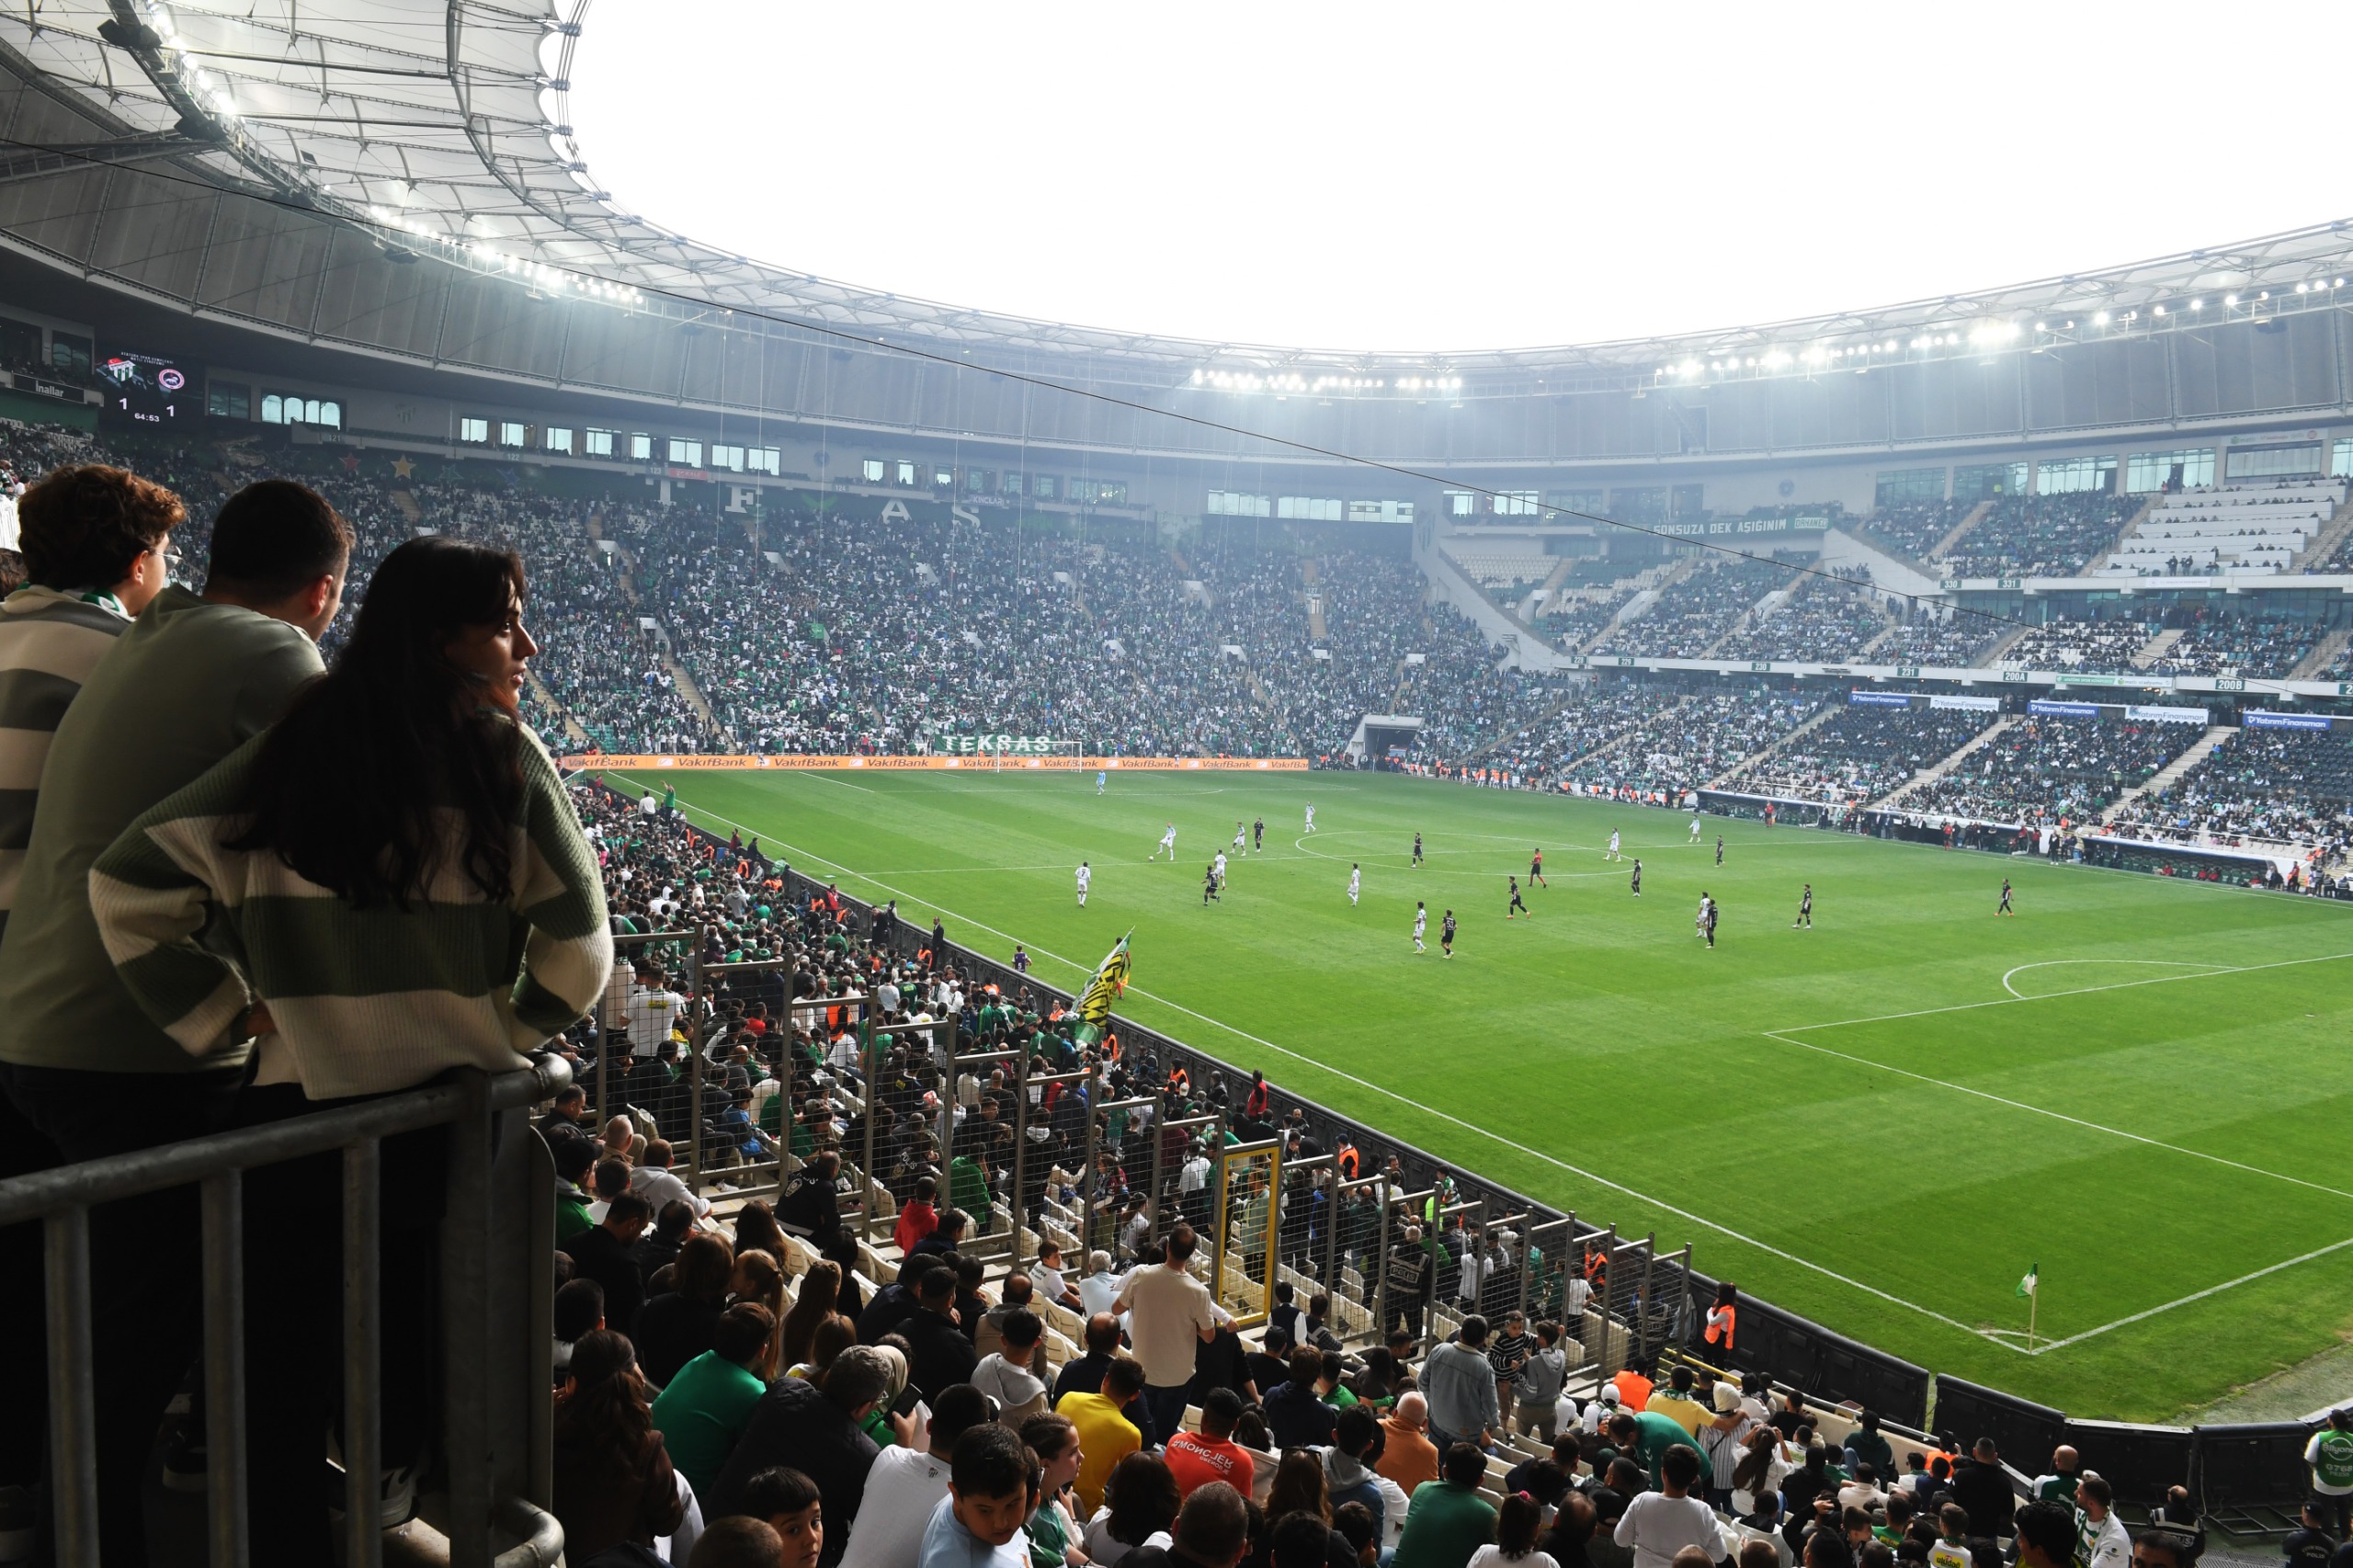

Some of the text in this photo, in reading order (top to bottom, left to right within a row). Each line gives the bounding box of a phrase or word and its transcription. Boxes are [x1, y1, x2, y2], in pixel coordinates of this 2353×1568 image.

[119, 398, 128, 410] 1
[166, 405, 175, 417] 1
[134, 413, 160, 423] 64:53
[507, 453, 520, 461] 122
[650, 467, 662, 475] 123
[1654, 524, 1704, 535] SONSUZA
[1710, 522, 1732, 534] DEK
[1944, 580, 1958, 588] 330
[2002, 579, 2016, 588] 331
[1755, 663, 1767, 671] 230
[1902, 667, 1915, 676] 231
[2005, 672, 2025, 681] 200A
[2218, 680, 2243, 689] 200B
[941, 733, 1051, 753] TEKSAS
